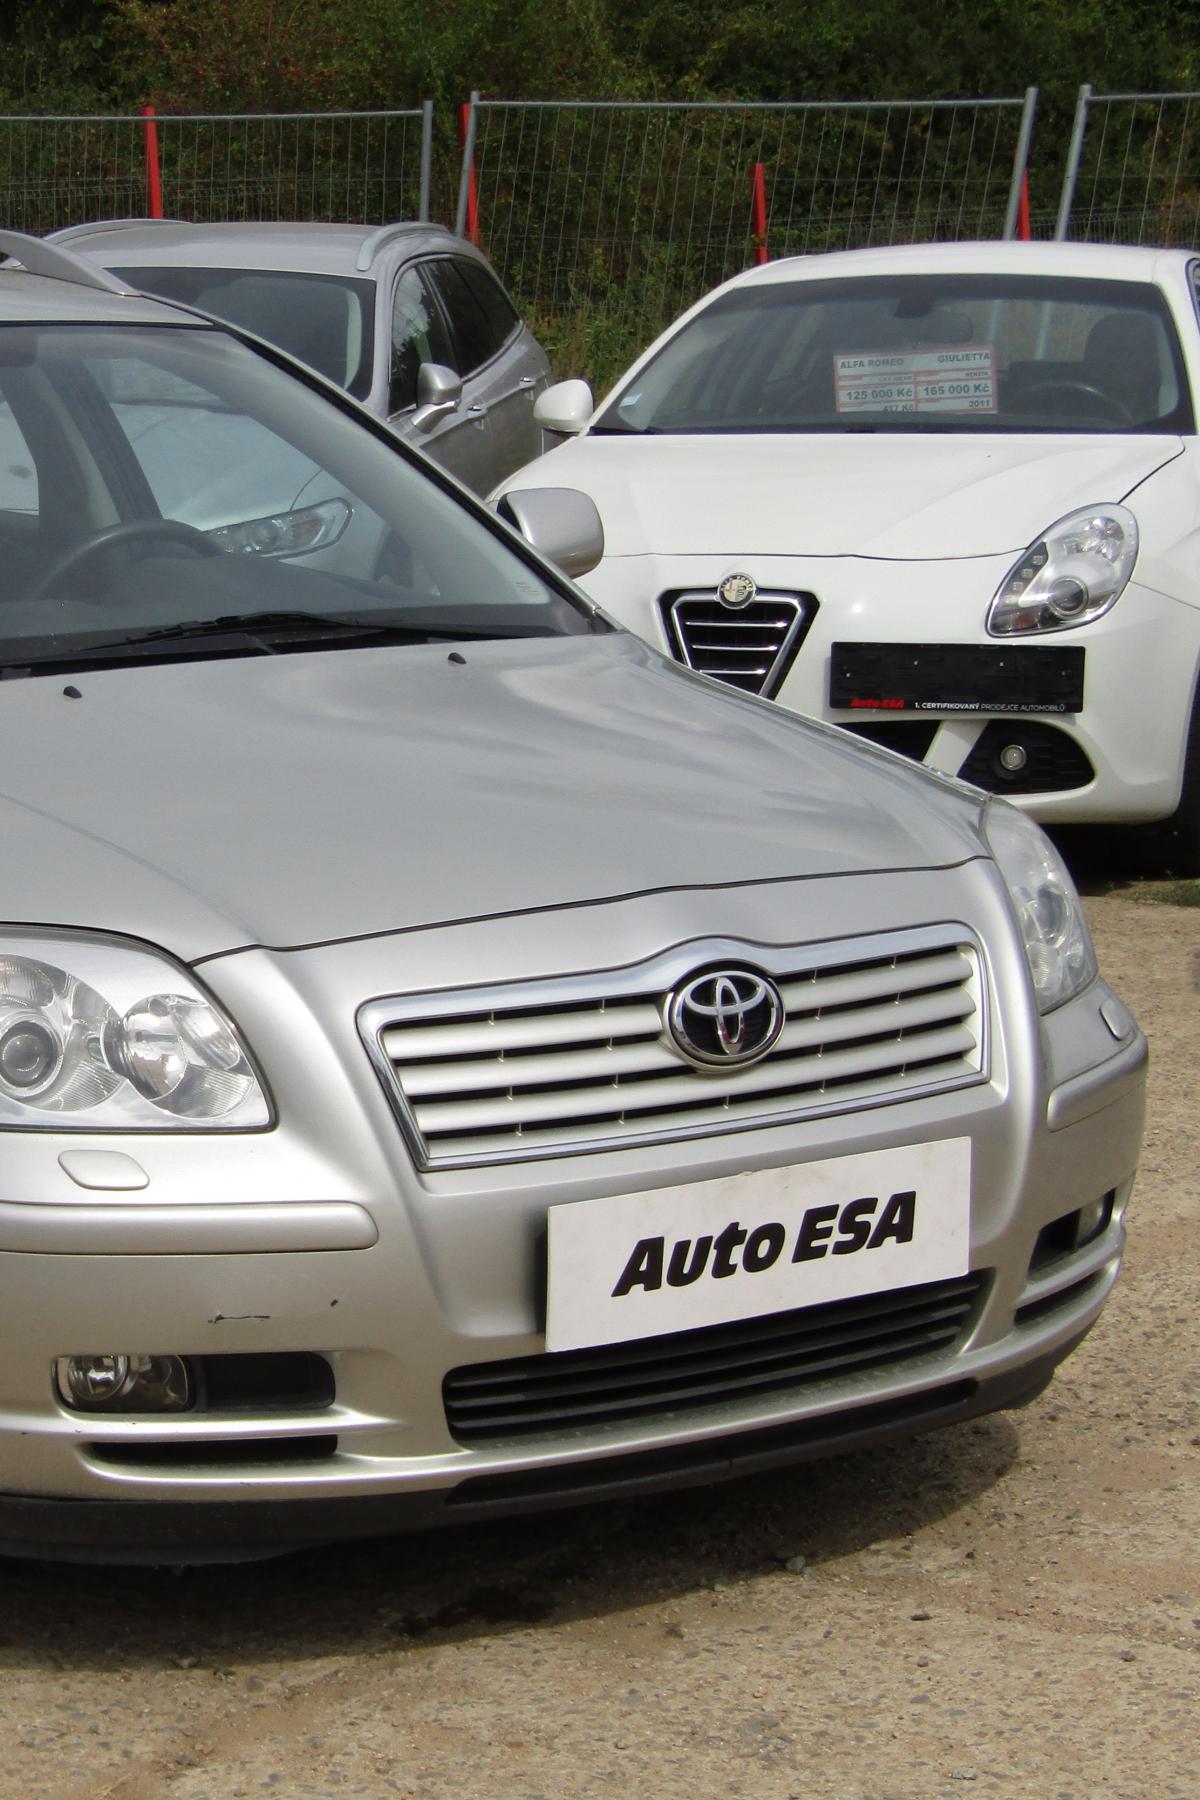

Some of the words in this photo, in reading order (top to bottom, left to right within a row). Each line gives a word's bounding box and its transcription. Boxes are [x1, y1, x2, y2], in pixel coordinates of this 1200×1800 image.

[840, 359, 865, 369] ALFA
[868, 358, 904, 367] ROMEO
[938, 352, 990, 363] GIULIETTA
[847, 390, 868, 401] 125
[872, 389, 893, 399] 000
[896, 387, 913, 397] Kč
[924, 386, 945, 396] 165
[948, 385, 970, 394] 000
[974, 383, 990, 393] Kč
[981, 703, 1020, 711] PRODEJCE
[611, 1222, 786, 1297] Auto
[791, 1190, 916, 1264] ESA
